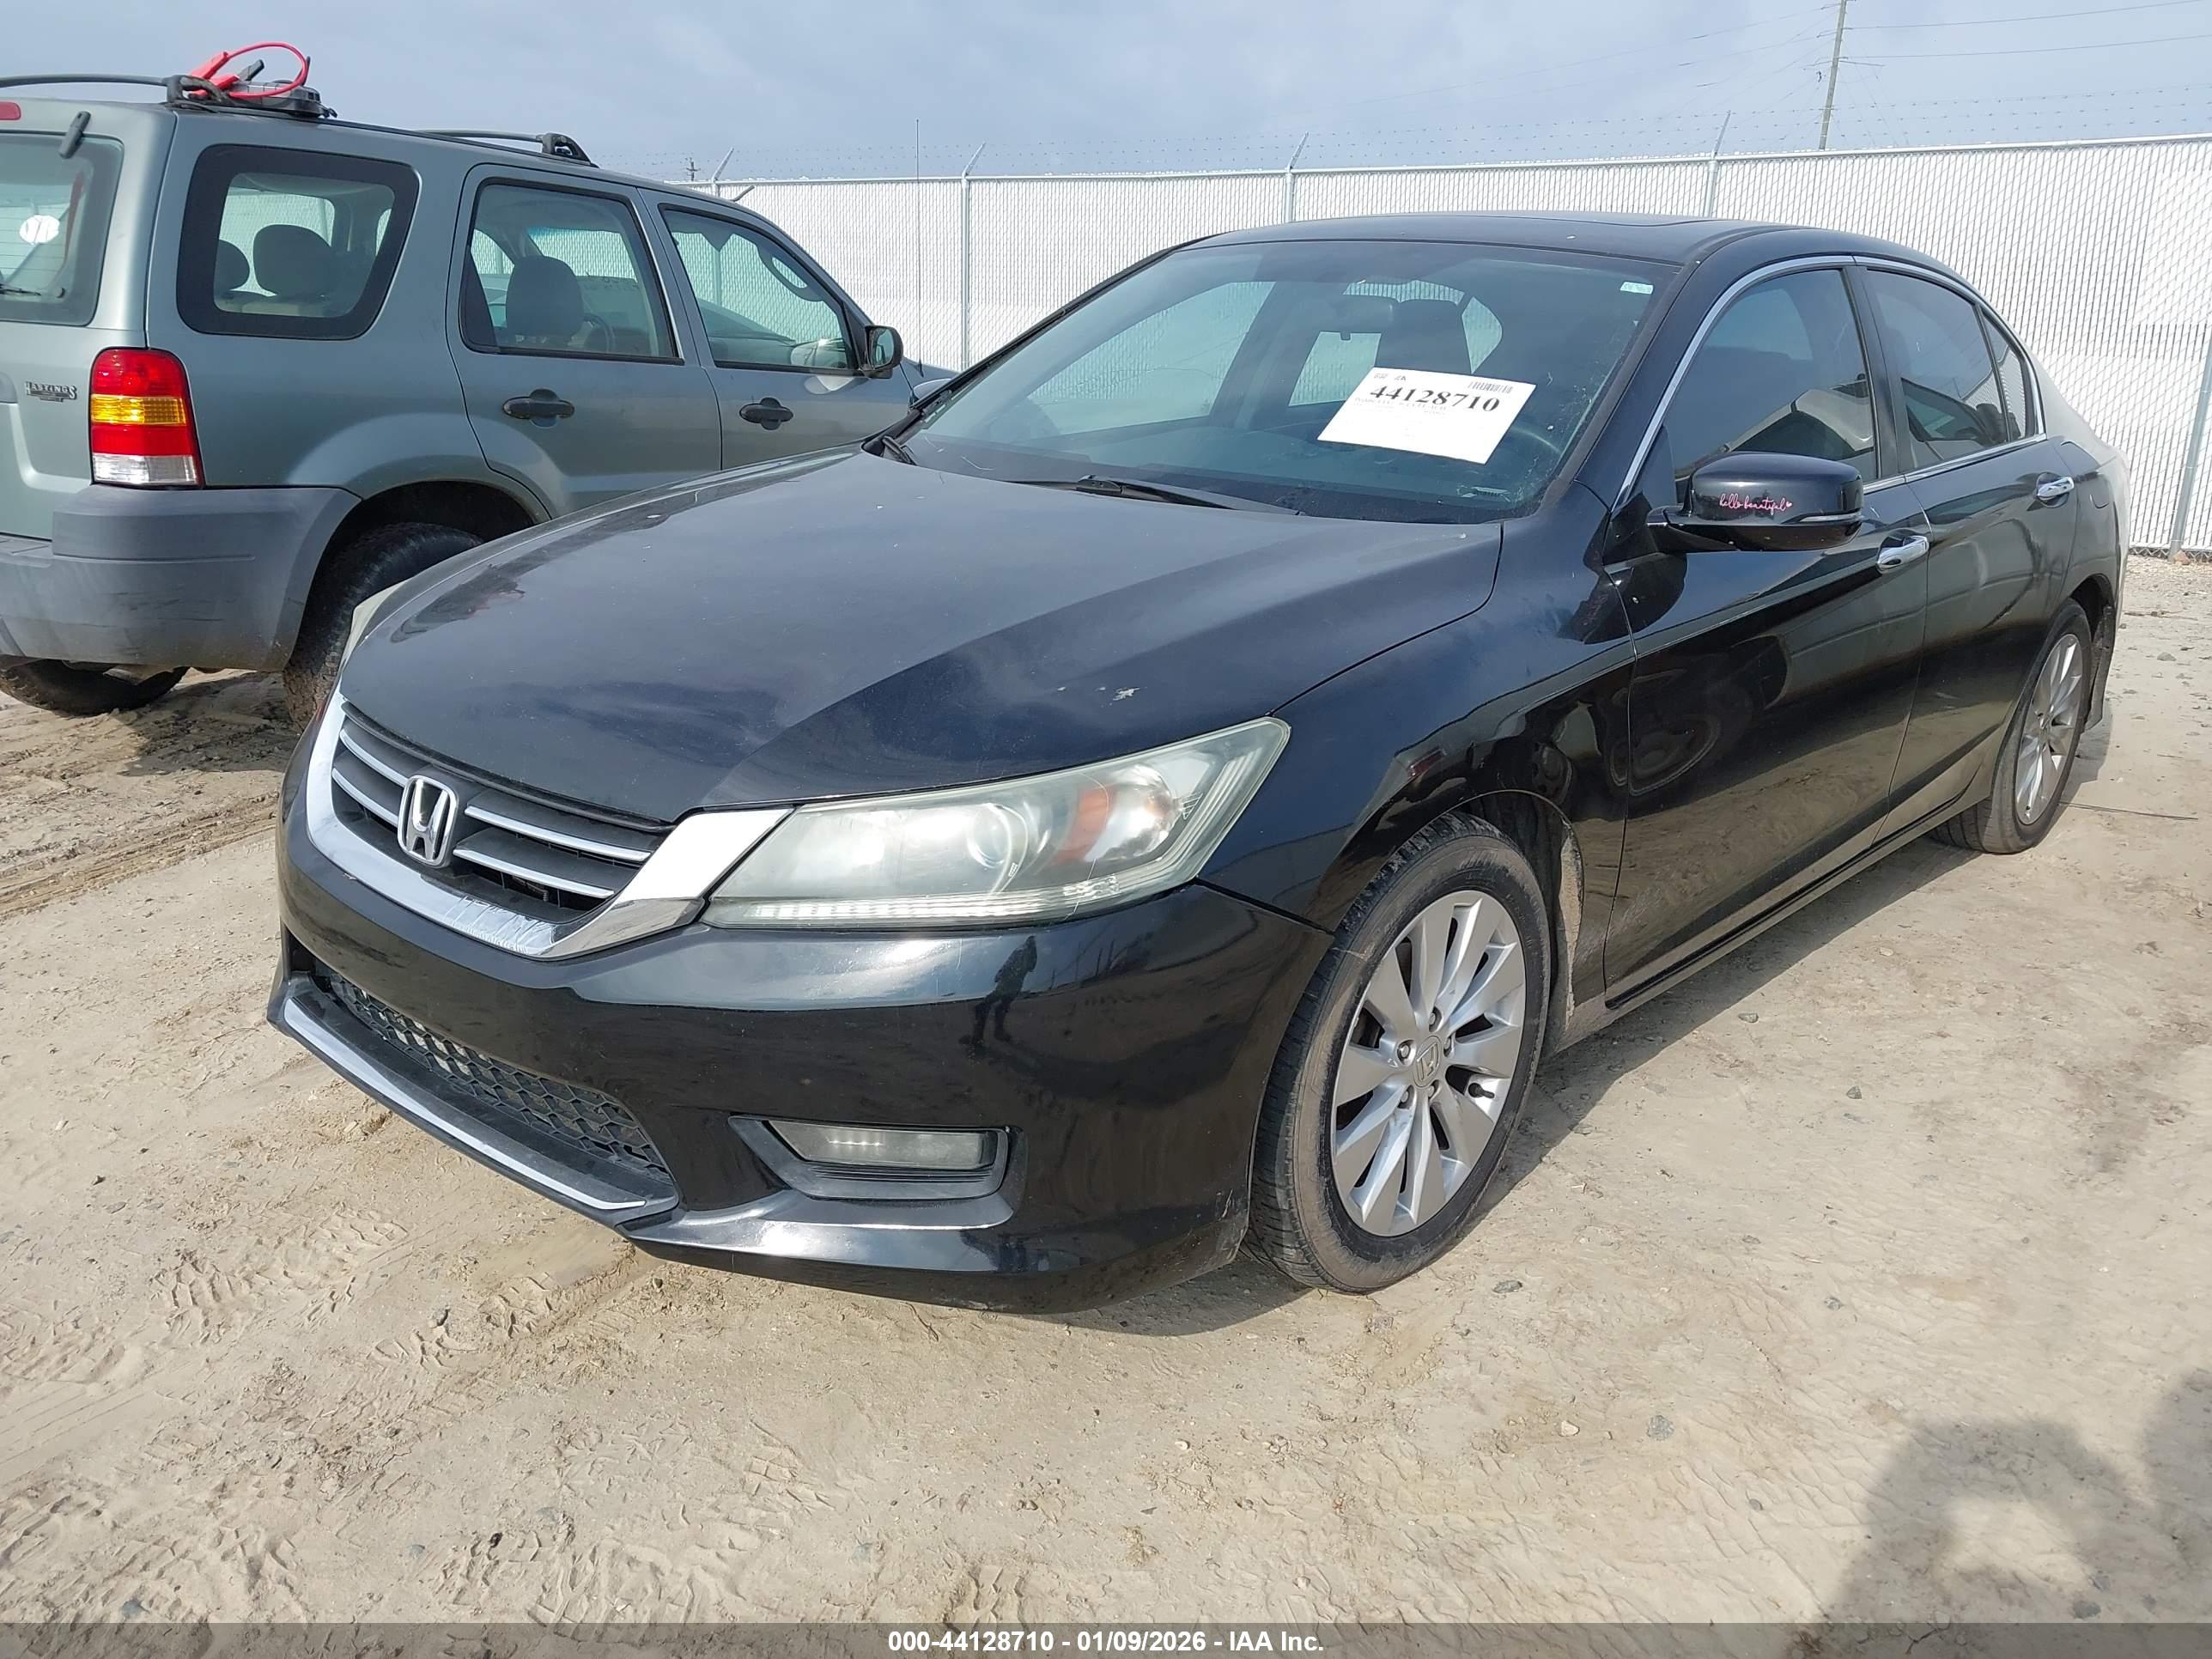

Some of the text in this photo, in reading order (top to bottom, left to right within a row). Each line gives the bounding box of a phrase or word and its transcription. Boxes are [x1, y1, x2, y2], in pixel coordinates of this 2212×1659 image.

[24, 380, 77, 400] HASTINGS
[1370, 385, 1501, 412] 44128710
[1719, 493, 1743, 509] hello
